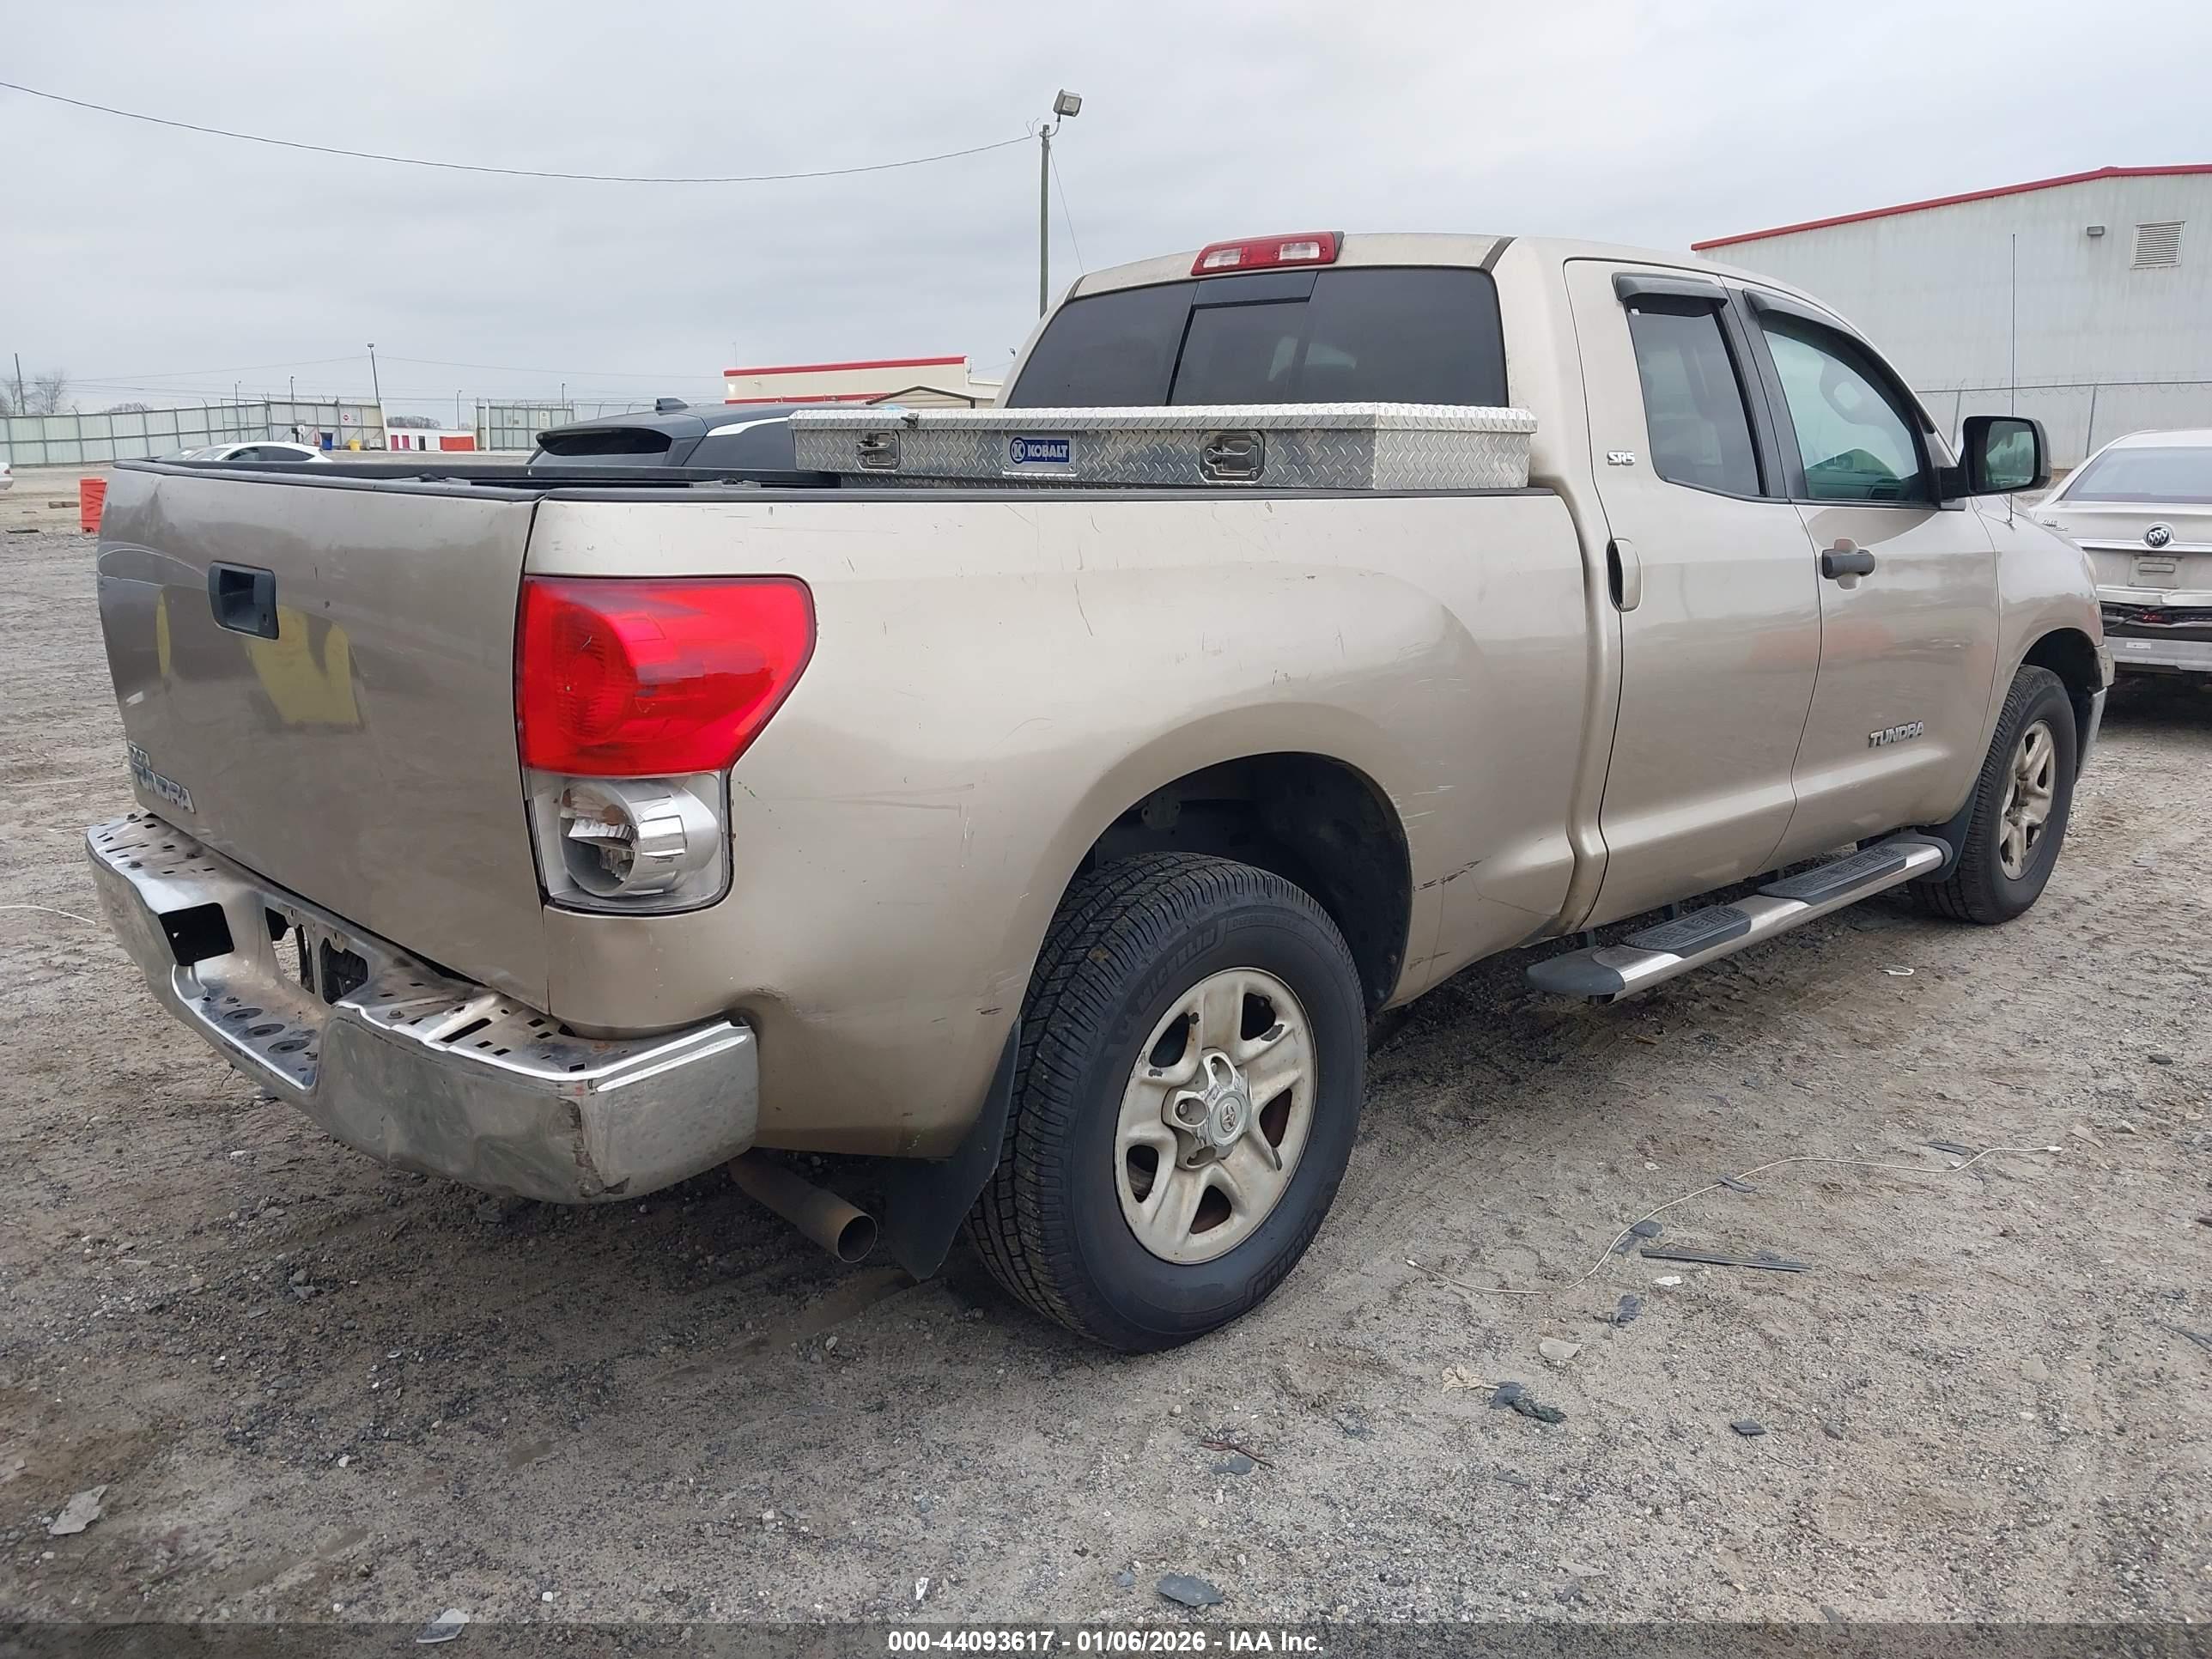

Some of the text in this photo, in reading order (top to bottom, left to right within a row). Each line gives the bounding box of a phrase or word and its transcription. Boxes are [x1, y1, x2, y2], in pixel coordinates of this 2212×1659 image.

[1027, 444, 1068, 458] KOBALT
[1607, 451, 1636, 465] SR5
[1869, 720, 1924, 748] TUNDRA
[131, 762, 197, 813] TUNDRA
[1137, 927, 1216, 1011] MICHELIN
